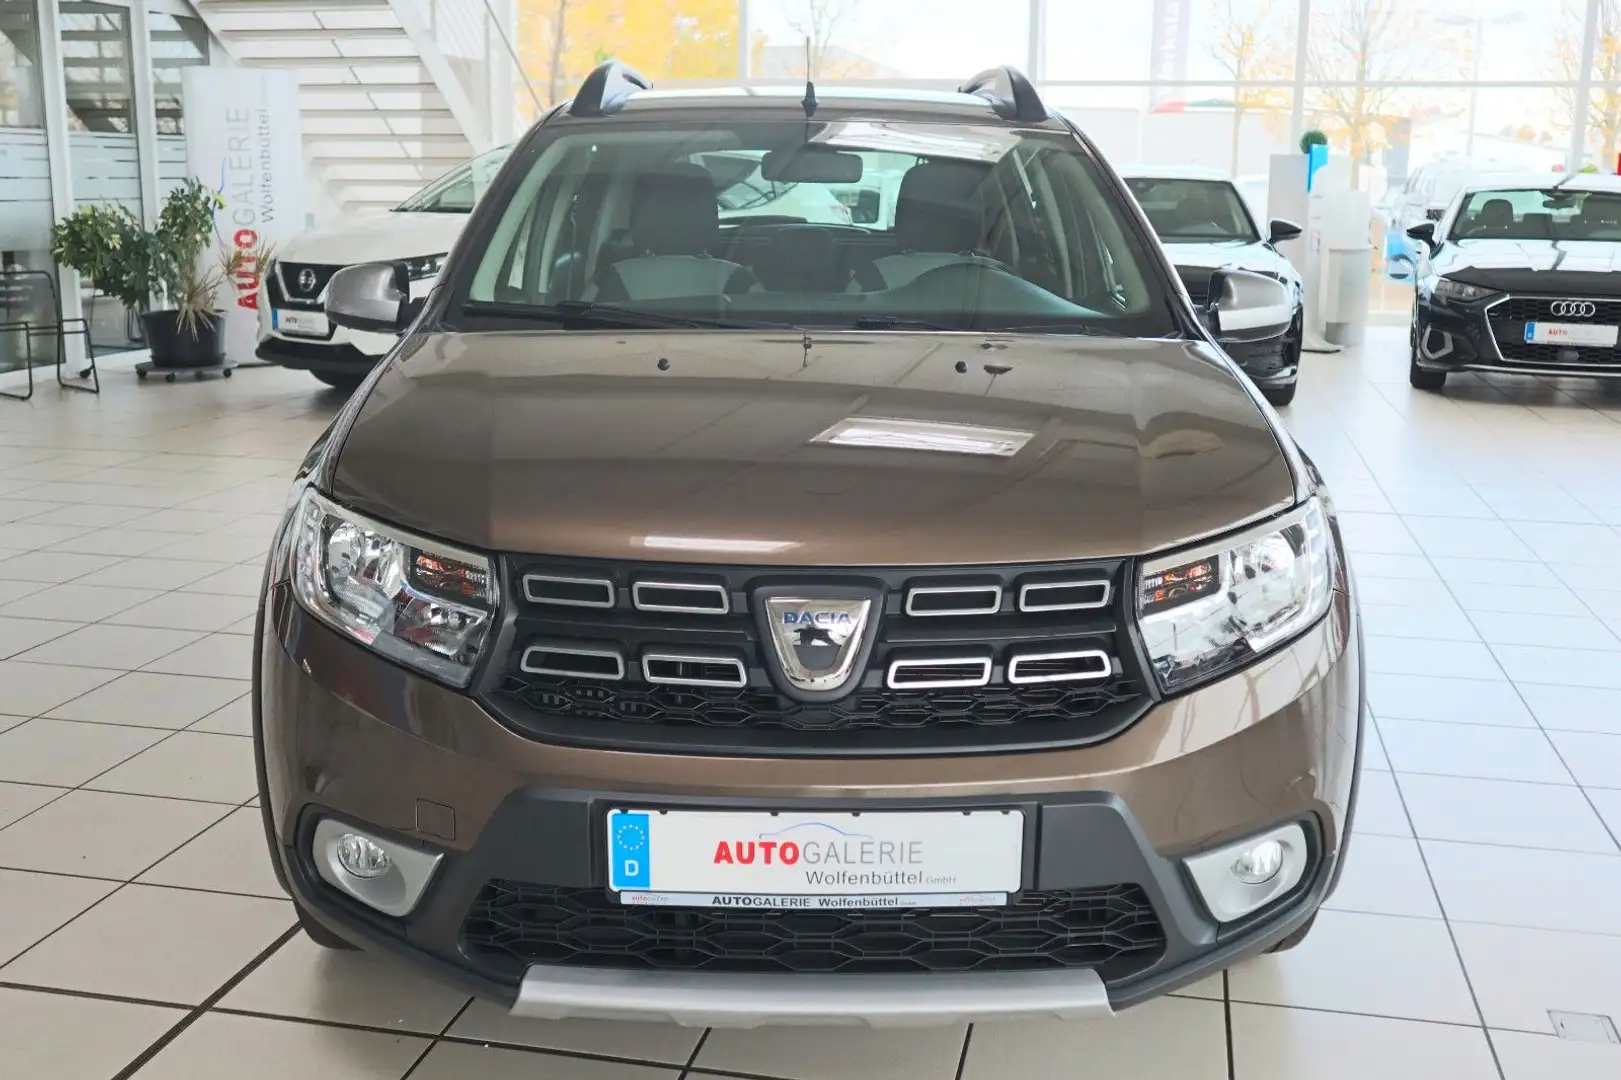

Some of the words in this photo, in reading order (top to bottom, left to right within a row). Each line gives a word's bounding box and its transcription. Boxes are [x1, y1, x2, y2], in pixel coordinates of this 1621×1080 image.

[782, 611, 852, 625] DACIA
[713, 841, 923, 865] AUTOGALERIE
[624, 859, 639, 877] D
[805, 870, 923, 885] Wolfenbüttel
[711, 896, 812, 908] AUTOGALERIE
[819, 897, 898, 907] Wolfenbüttel
